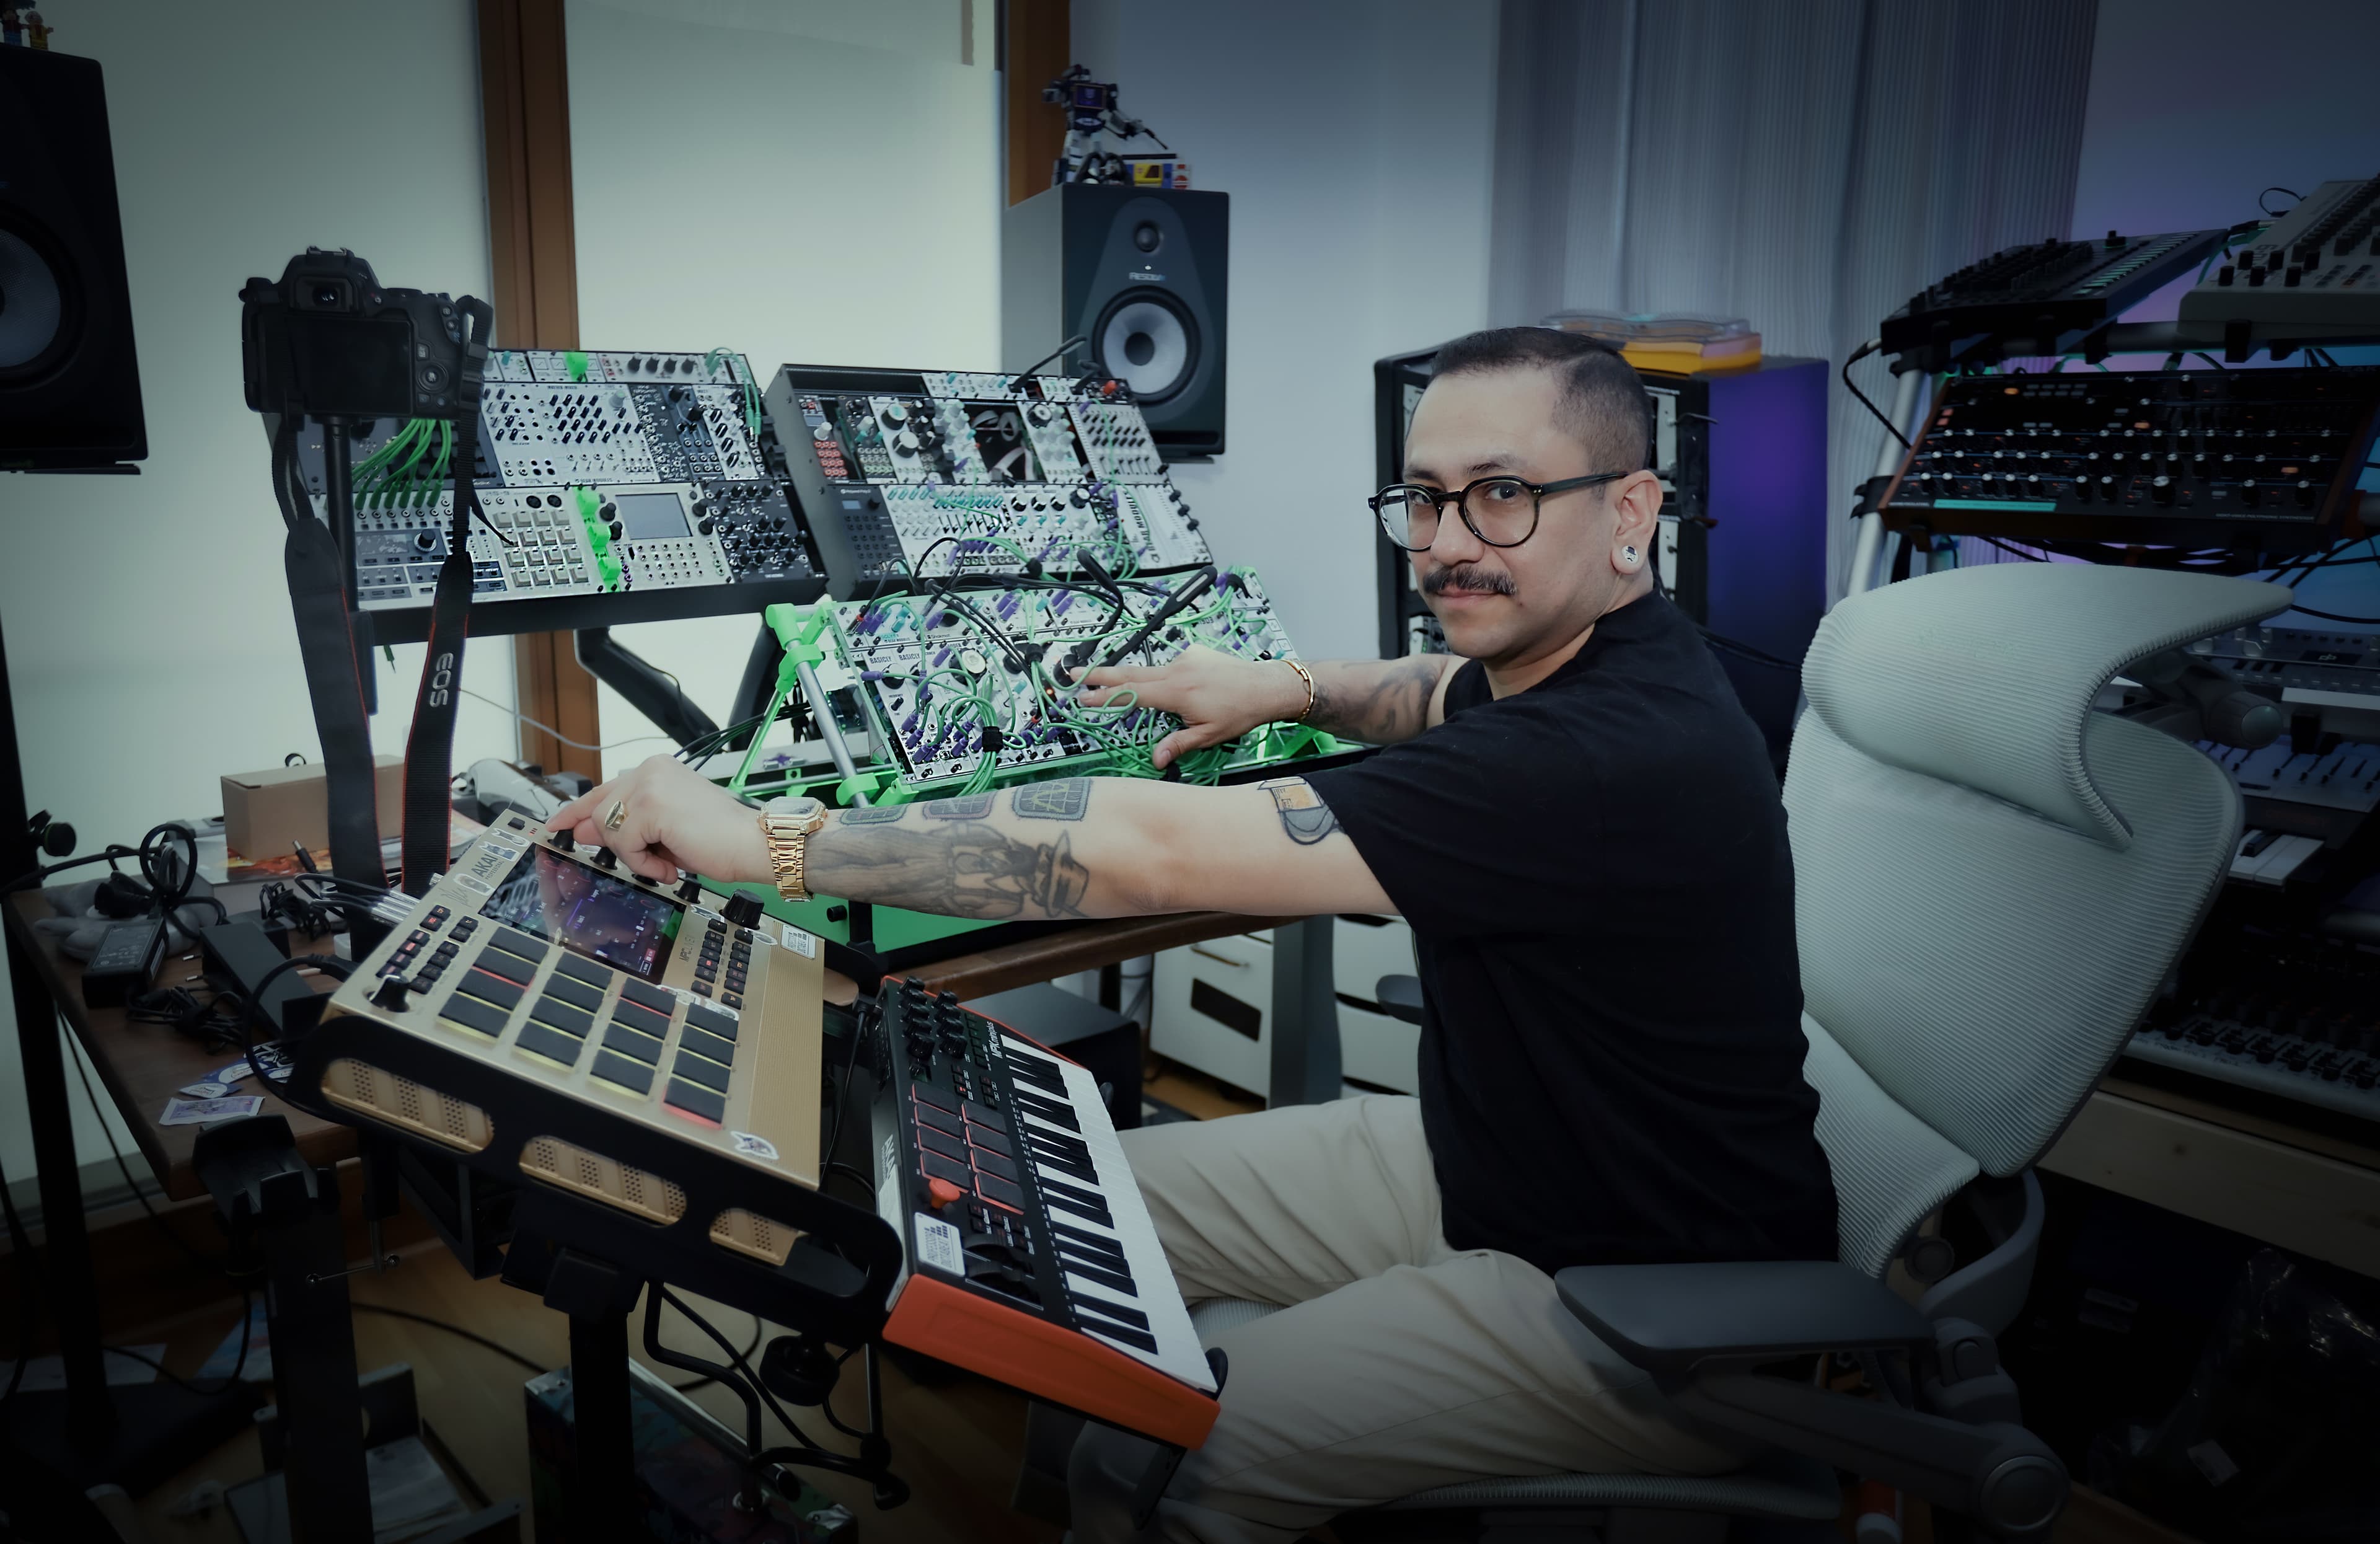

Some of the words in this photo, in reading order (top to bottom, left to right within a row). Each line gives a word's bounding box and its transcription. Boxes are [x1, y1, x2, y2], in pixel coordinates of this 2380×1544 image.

[870, 656, 891, 664] BASICLY
[430, 653, 454, 707] EOS
[471, 854, 498, 878] AKAI
[884, 1134, 895, 1181] AKA
